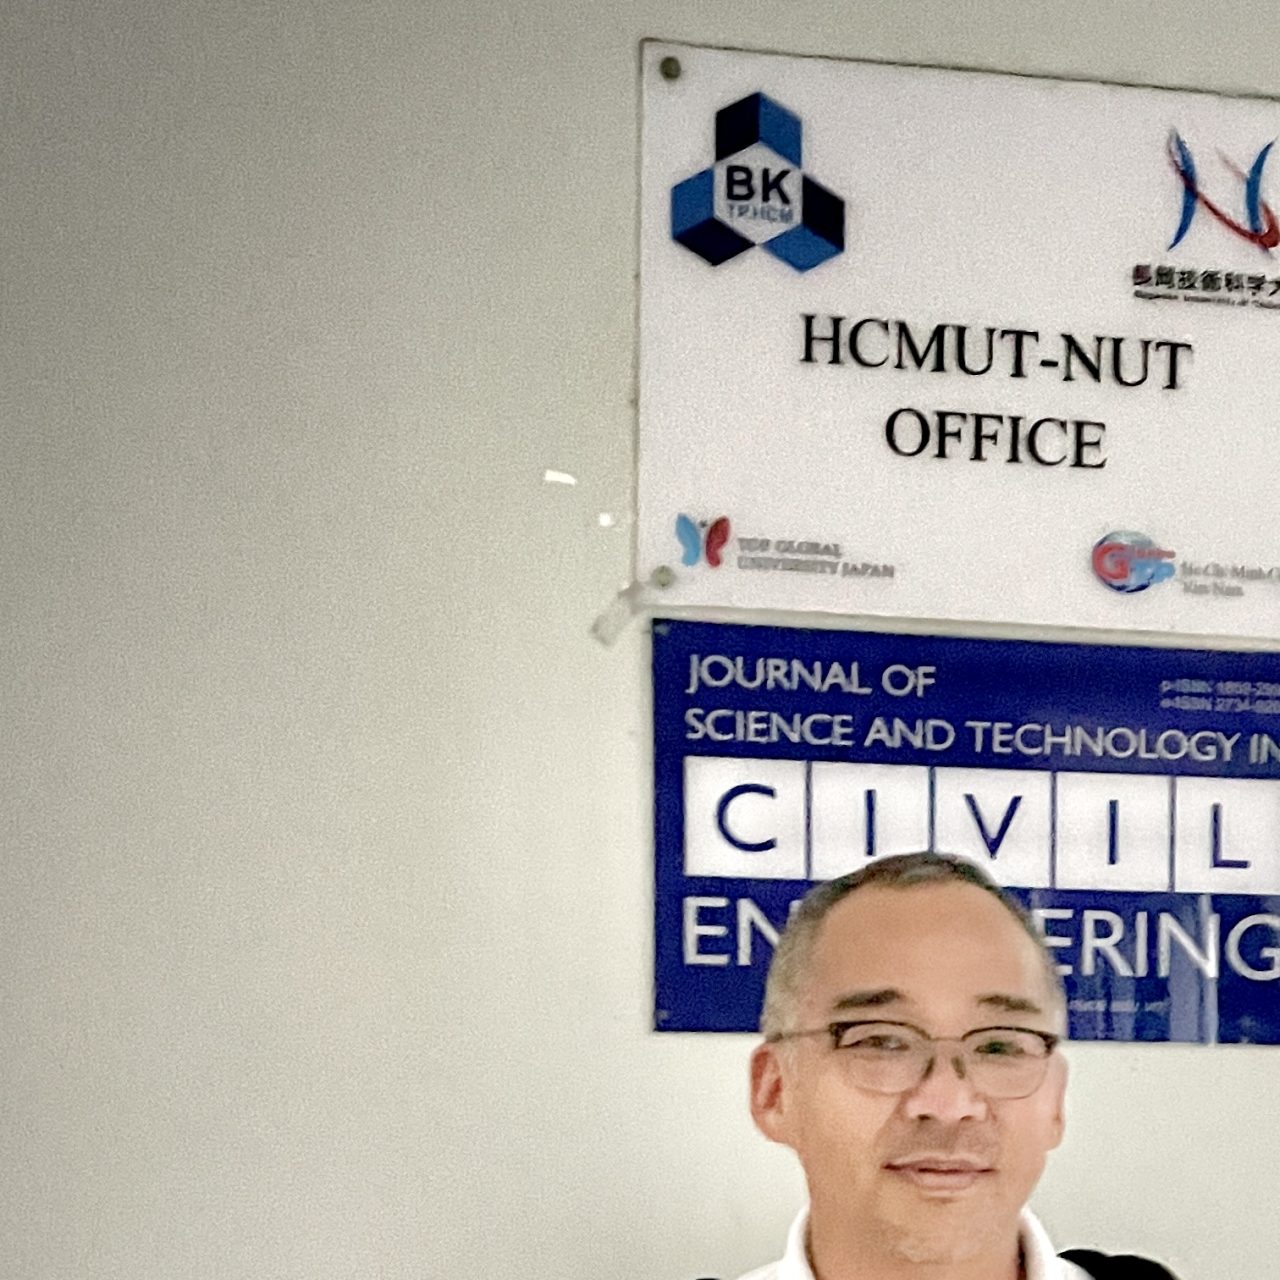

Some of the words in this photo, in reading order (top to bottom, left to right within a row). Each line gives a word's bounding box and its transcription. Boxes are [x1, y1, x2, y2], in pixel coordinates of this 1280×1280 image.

[726, 165, 791, 205] BK
[800, 313, 1193, 390] HCMUT-NUT
[885, 407, 1107, 469] OFFICE
[685, 654, 872, 694] JOURNAL
[881, 664, 936, 698] OF
[685, 707, 856, 746] SCIENCE
[864, 716, 956, 751] AND
[964, 720, 1241, 763] TECHNOLOGY
[716, 783, 1252, 869] CIVIL
